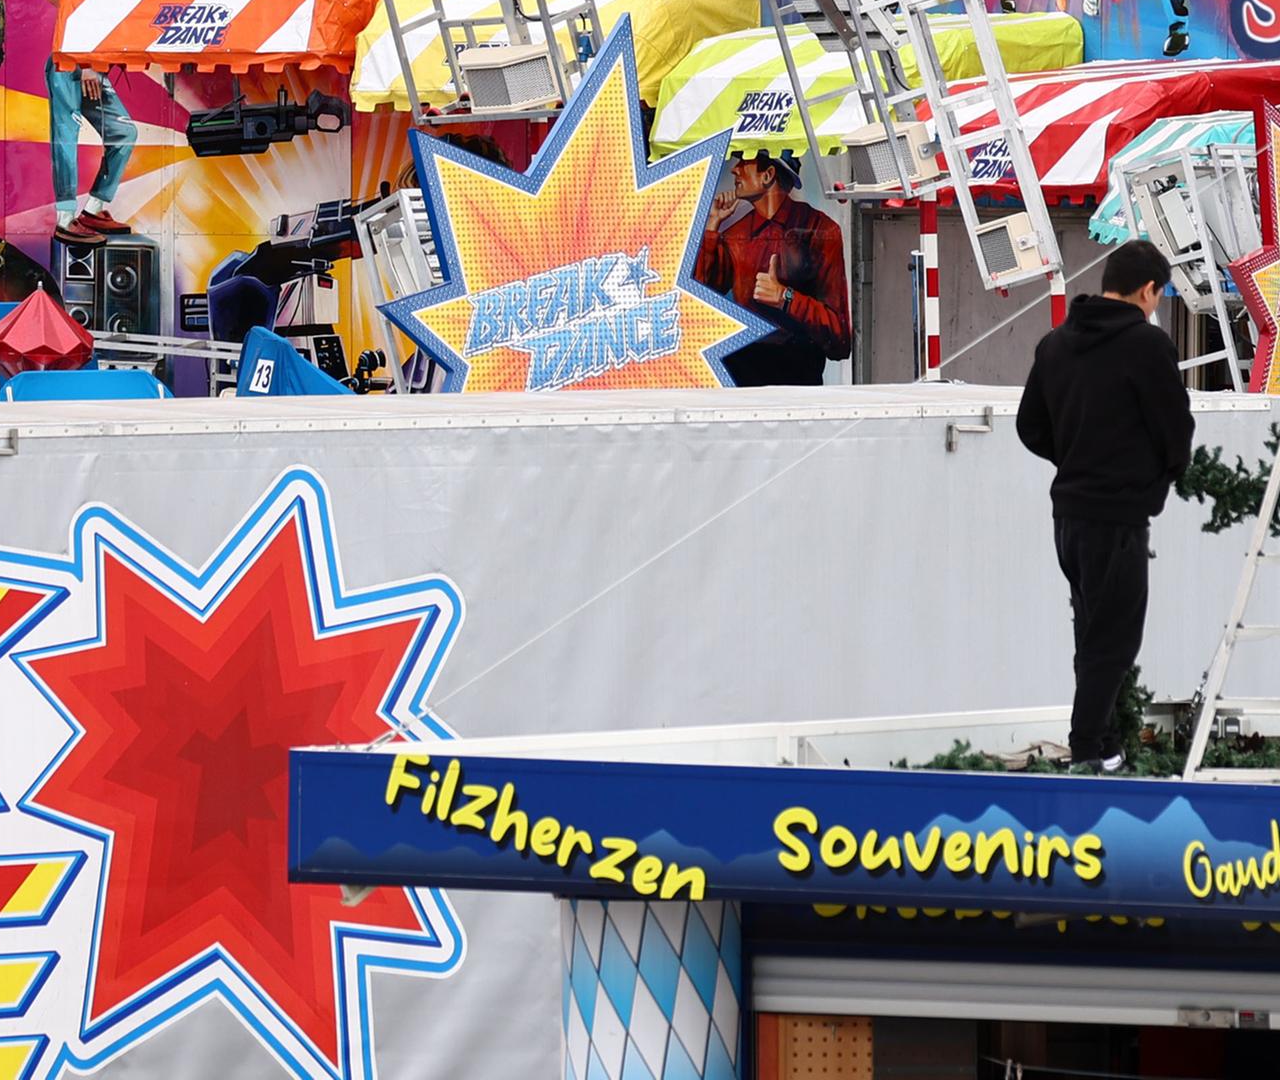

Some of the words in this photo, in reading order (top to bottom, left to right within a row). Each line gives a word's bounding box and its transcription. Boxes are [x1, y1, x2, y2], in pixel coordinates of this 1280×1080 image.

[154, 5, 223, 25] BREAK
[157, 25, 228, 46] DANCE
[737, 91, 789, 113] BREAK
[737, 112, 791, 133] DANCE
[466, 256, 622, 353] BREAK
[518, 293, 679, 391] DANCE
[255, 365, 272, 389] 13
[384, 752, 708, 902] Filzherzen
[772, 806, 1104, 882] Souvenirs
